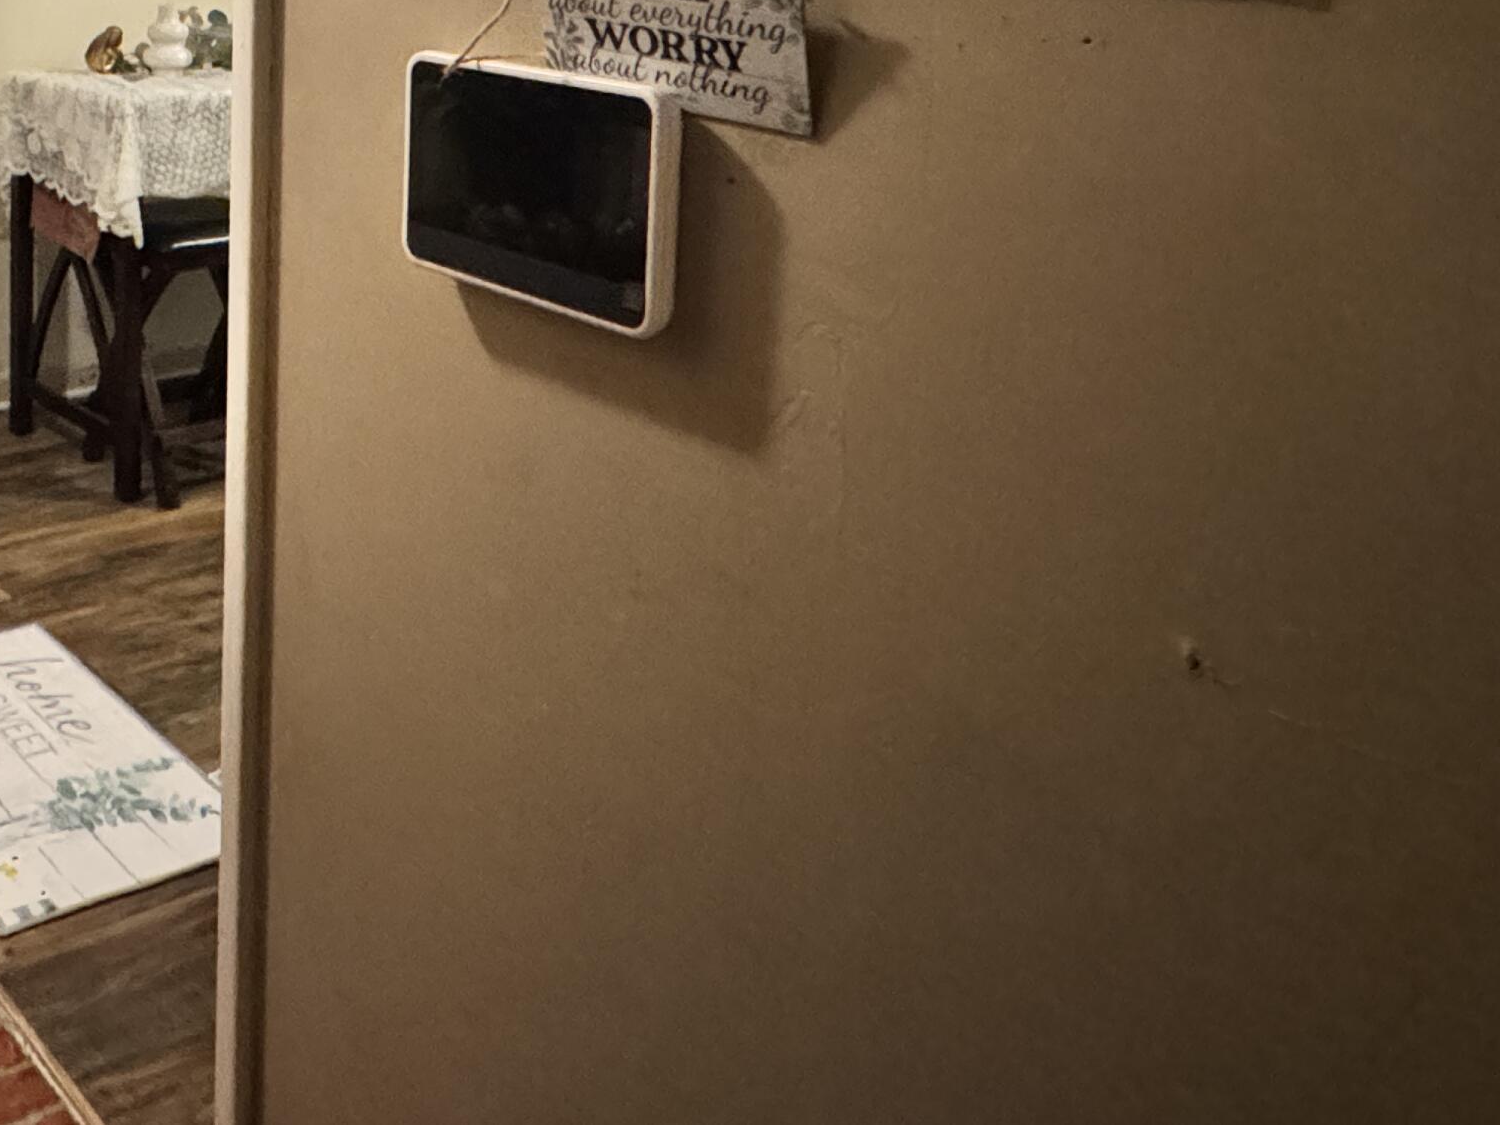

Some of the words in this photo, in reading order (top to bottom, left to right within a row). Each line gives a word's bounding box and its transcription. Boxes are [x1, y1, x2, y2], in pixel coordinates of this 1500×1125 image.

[584, 17, 749, 74] WORRY
[629, 0, 789, 55] everything
[572, 41, 650, 82] about
[654, 61, 771, 116] nothing
